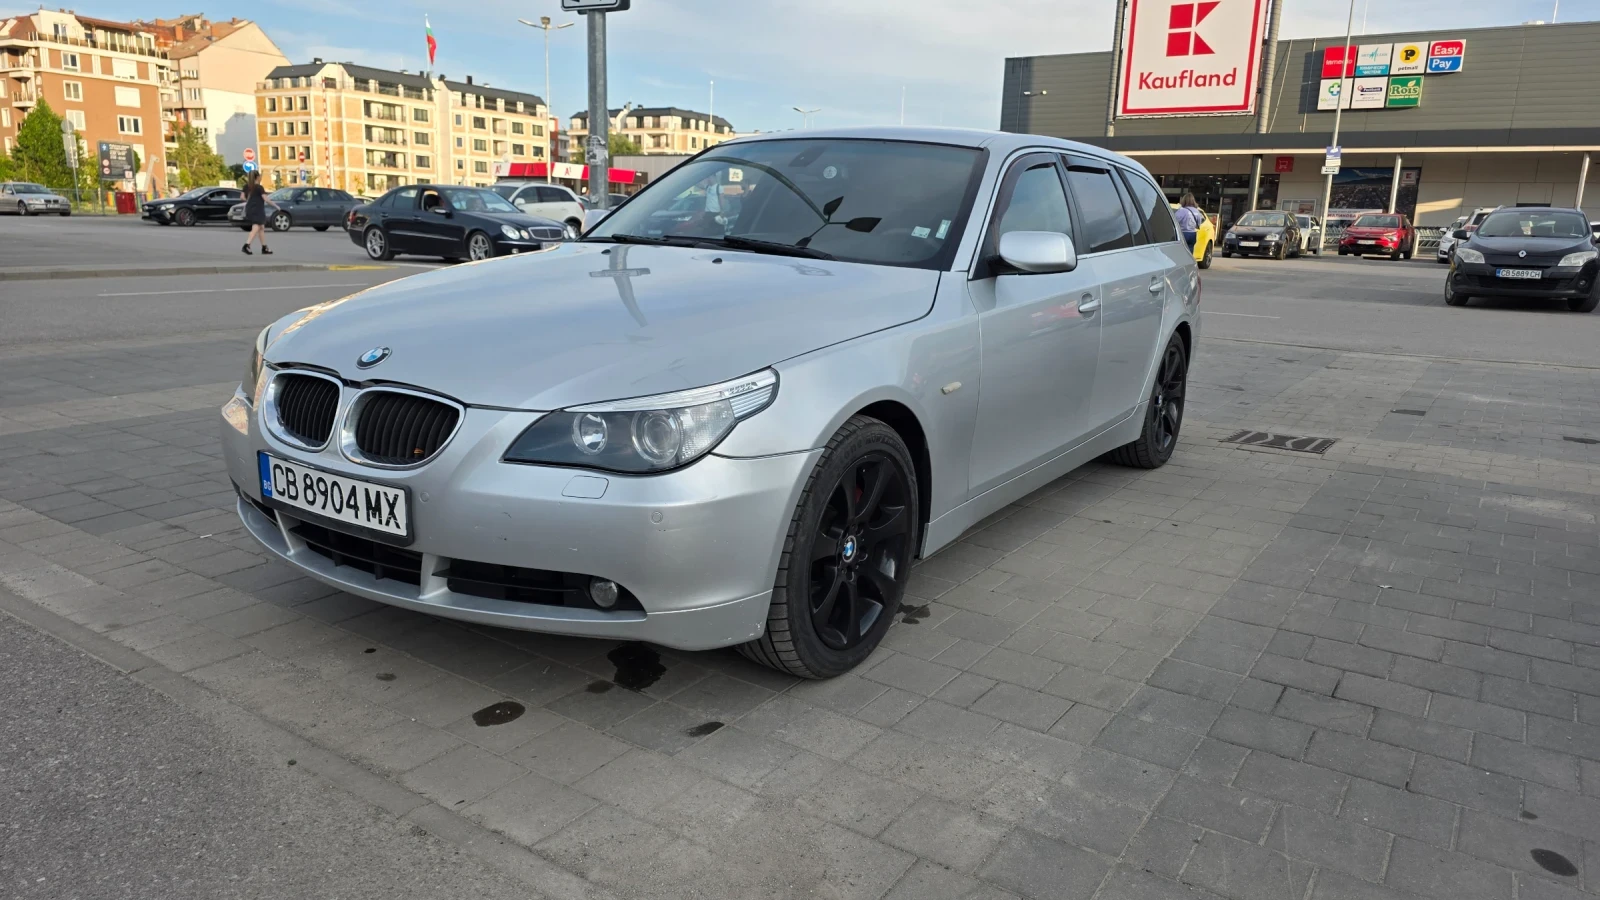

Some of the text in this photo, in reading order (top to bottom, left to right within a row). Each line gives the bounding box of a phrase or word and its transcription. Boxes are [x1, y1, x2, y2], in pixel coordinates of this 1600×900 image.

[1434, 45, 1460, 56] Easy
[1432, 58, 1452, 70] Pay
[1138, 67, 1237, 90] Kaufland
[1390, 85, 1419, 95] Rois
[263, 479, 272, 491] BG
[273, 463, 401, 530] CB 8904 MX
